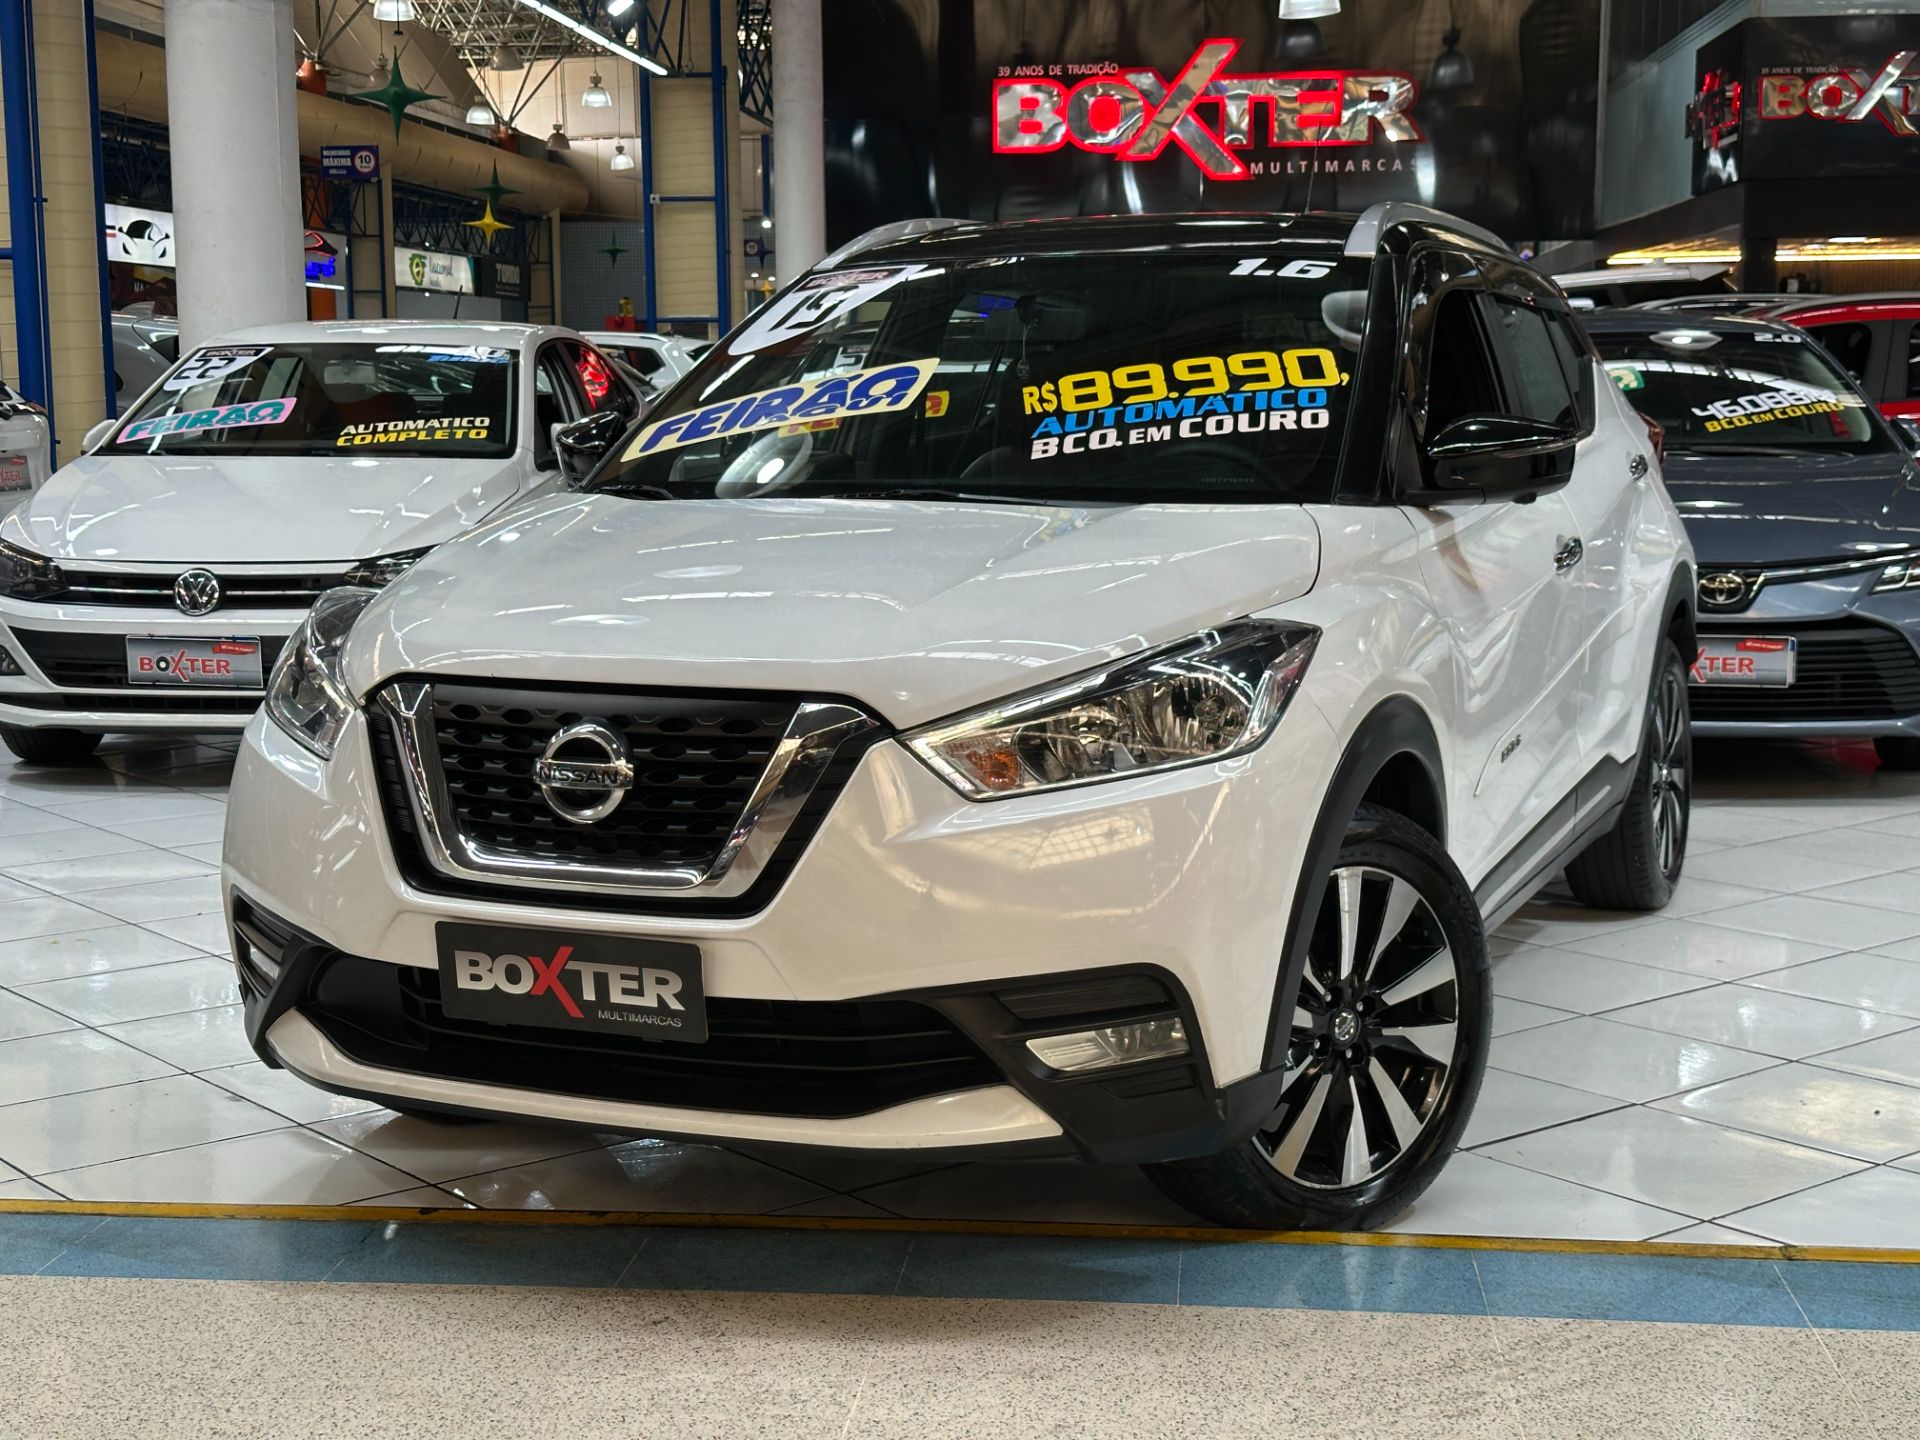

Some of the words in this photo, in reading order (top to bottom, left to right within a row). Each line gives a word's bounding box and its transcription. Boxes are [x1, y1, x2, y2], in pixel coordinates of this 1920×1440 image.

[997, 66, 1010, 77] 39
[1015, 65, 1044, 76] ANOS
[1049, 64, 1062, 75] DE
[1068, 61, 1118, 76] TRADIÇÃO
[992, 38, 1427, 180] BOXTER
[358, 154, 371, 164] 10
[1229, 258, 1337, 278] 1.6
[1754, 332, 1801, 343] 2.0
[173, 357, 237, 381] 22
[639, 366, 921, 453] FEIRÃO
[1753, 413, 1775, 425] EM
[1775, 401, 1845, 419] COURO
[340, 417, 490, 435] AUTOMATICO
[1129, 424, 1171, 445] EM
[1179, 408, 1330, 439] COURO
[336, 428, 488, 446] COMPLETO
[138, 649, 232, 682] BOXTER
[540, 766, 619, 784] NISSAN
[454, 945, 686, 1019] BOXTER
[597, 1009, 682, 1027] MULTIMARCAS
